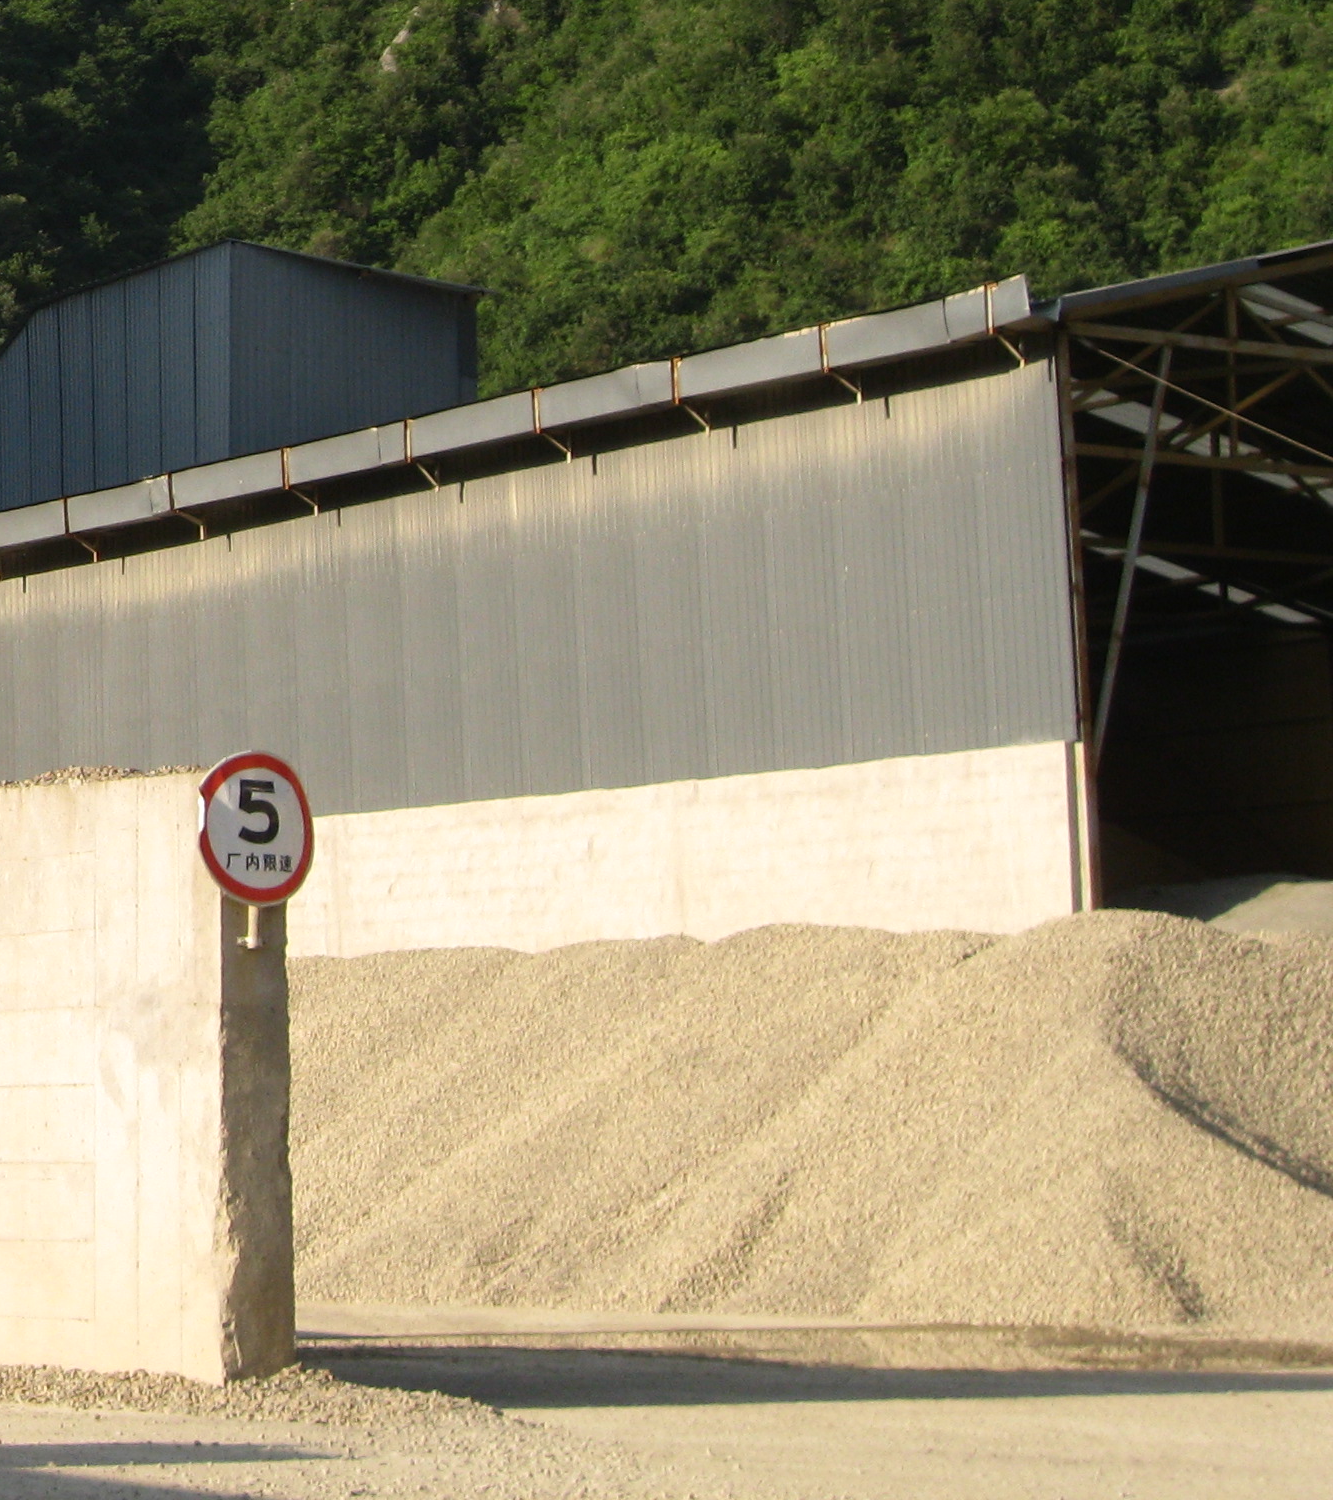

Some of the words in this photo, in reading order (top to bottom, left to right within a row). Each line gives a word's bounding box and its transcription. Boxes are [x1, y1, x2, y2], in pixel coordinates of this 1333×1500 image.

[238, 779, 280, 844] 5
[225, 852, 293, 872] 厂内限速
